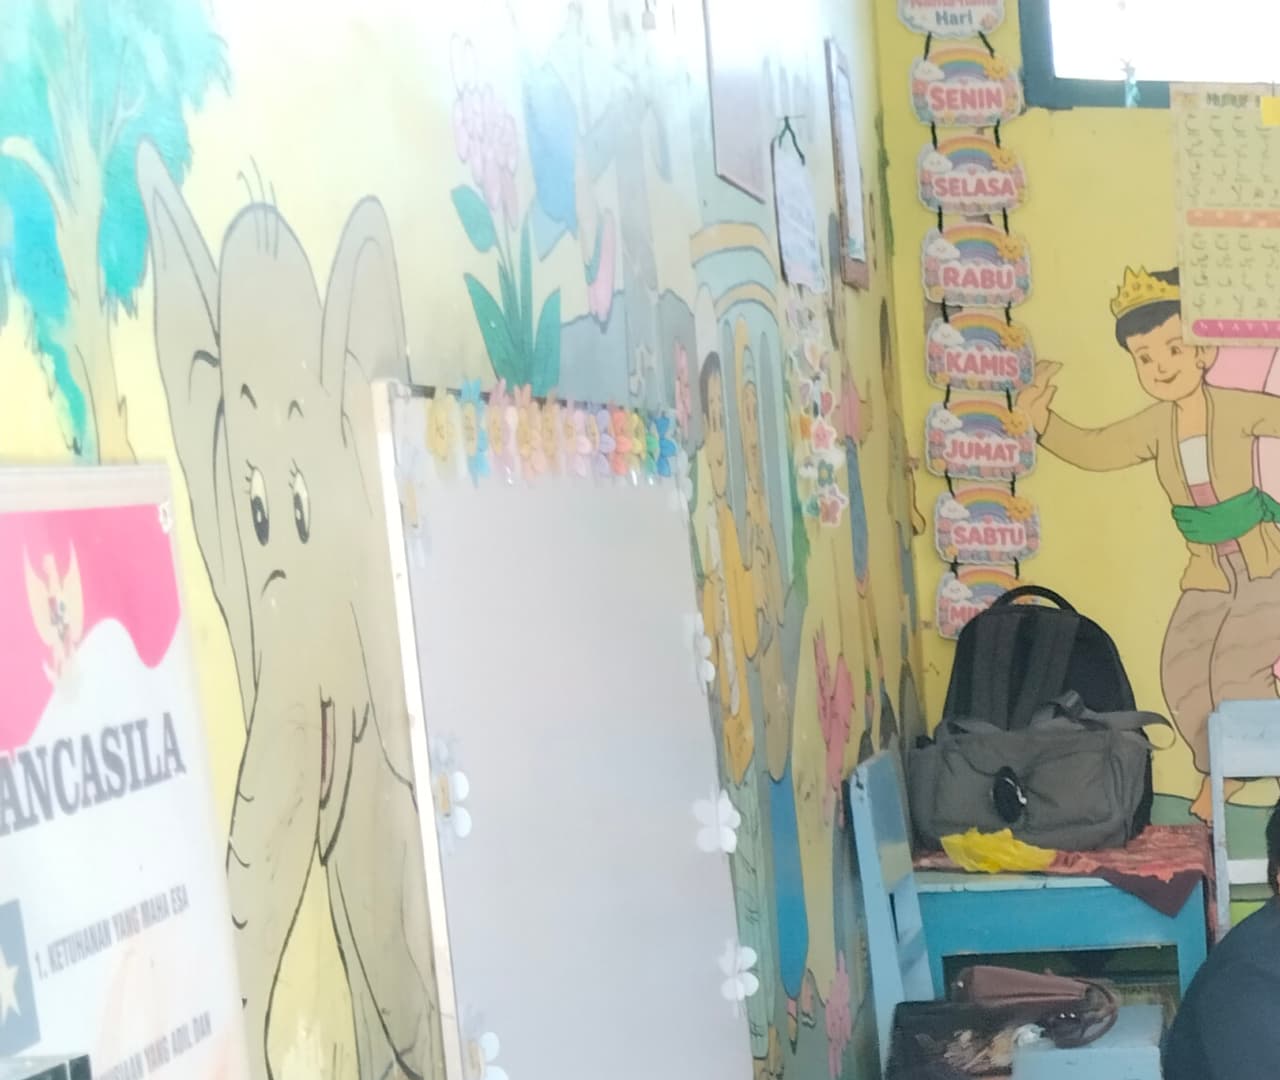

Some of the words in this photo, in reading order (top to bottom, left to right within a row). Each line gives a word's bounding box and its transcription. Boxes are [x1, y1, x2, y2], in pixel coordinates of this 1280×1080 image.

[936, 10, 973, 25] Hari
[930, 85, 1003, 110] SENIN
[933, 177, 1015, 198] SELASA
[943, 266, 1014, 289] RABU
[945, 351, 1019, 378] KAMIS
[946, 439, 1019, 462] JUMAT
[953, 526, 1025, 546] SABTU
[46, 917, 112, 974] KETUHANAN
[111, 903, 140, 944] YANG
[139, 890, 170, 929] MAHA
[168, 880, 189, 915] ESA
